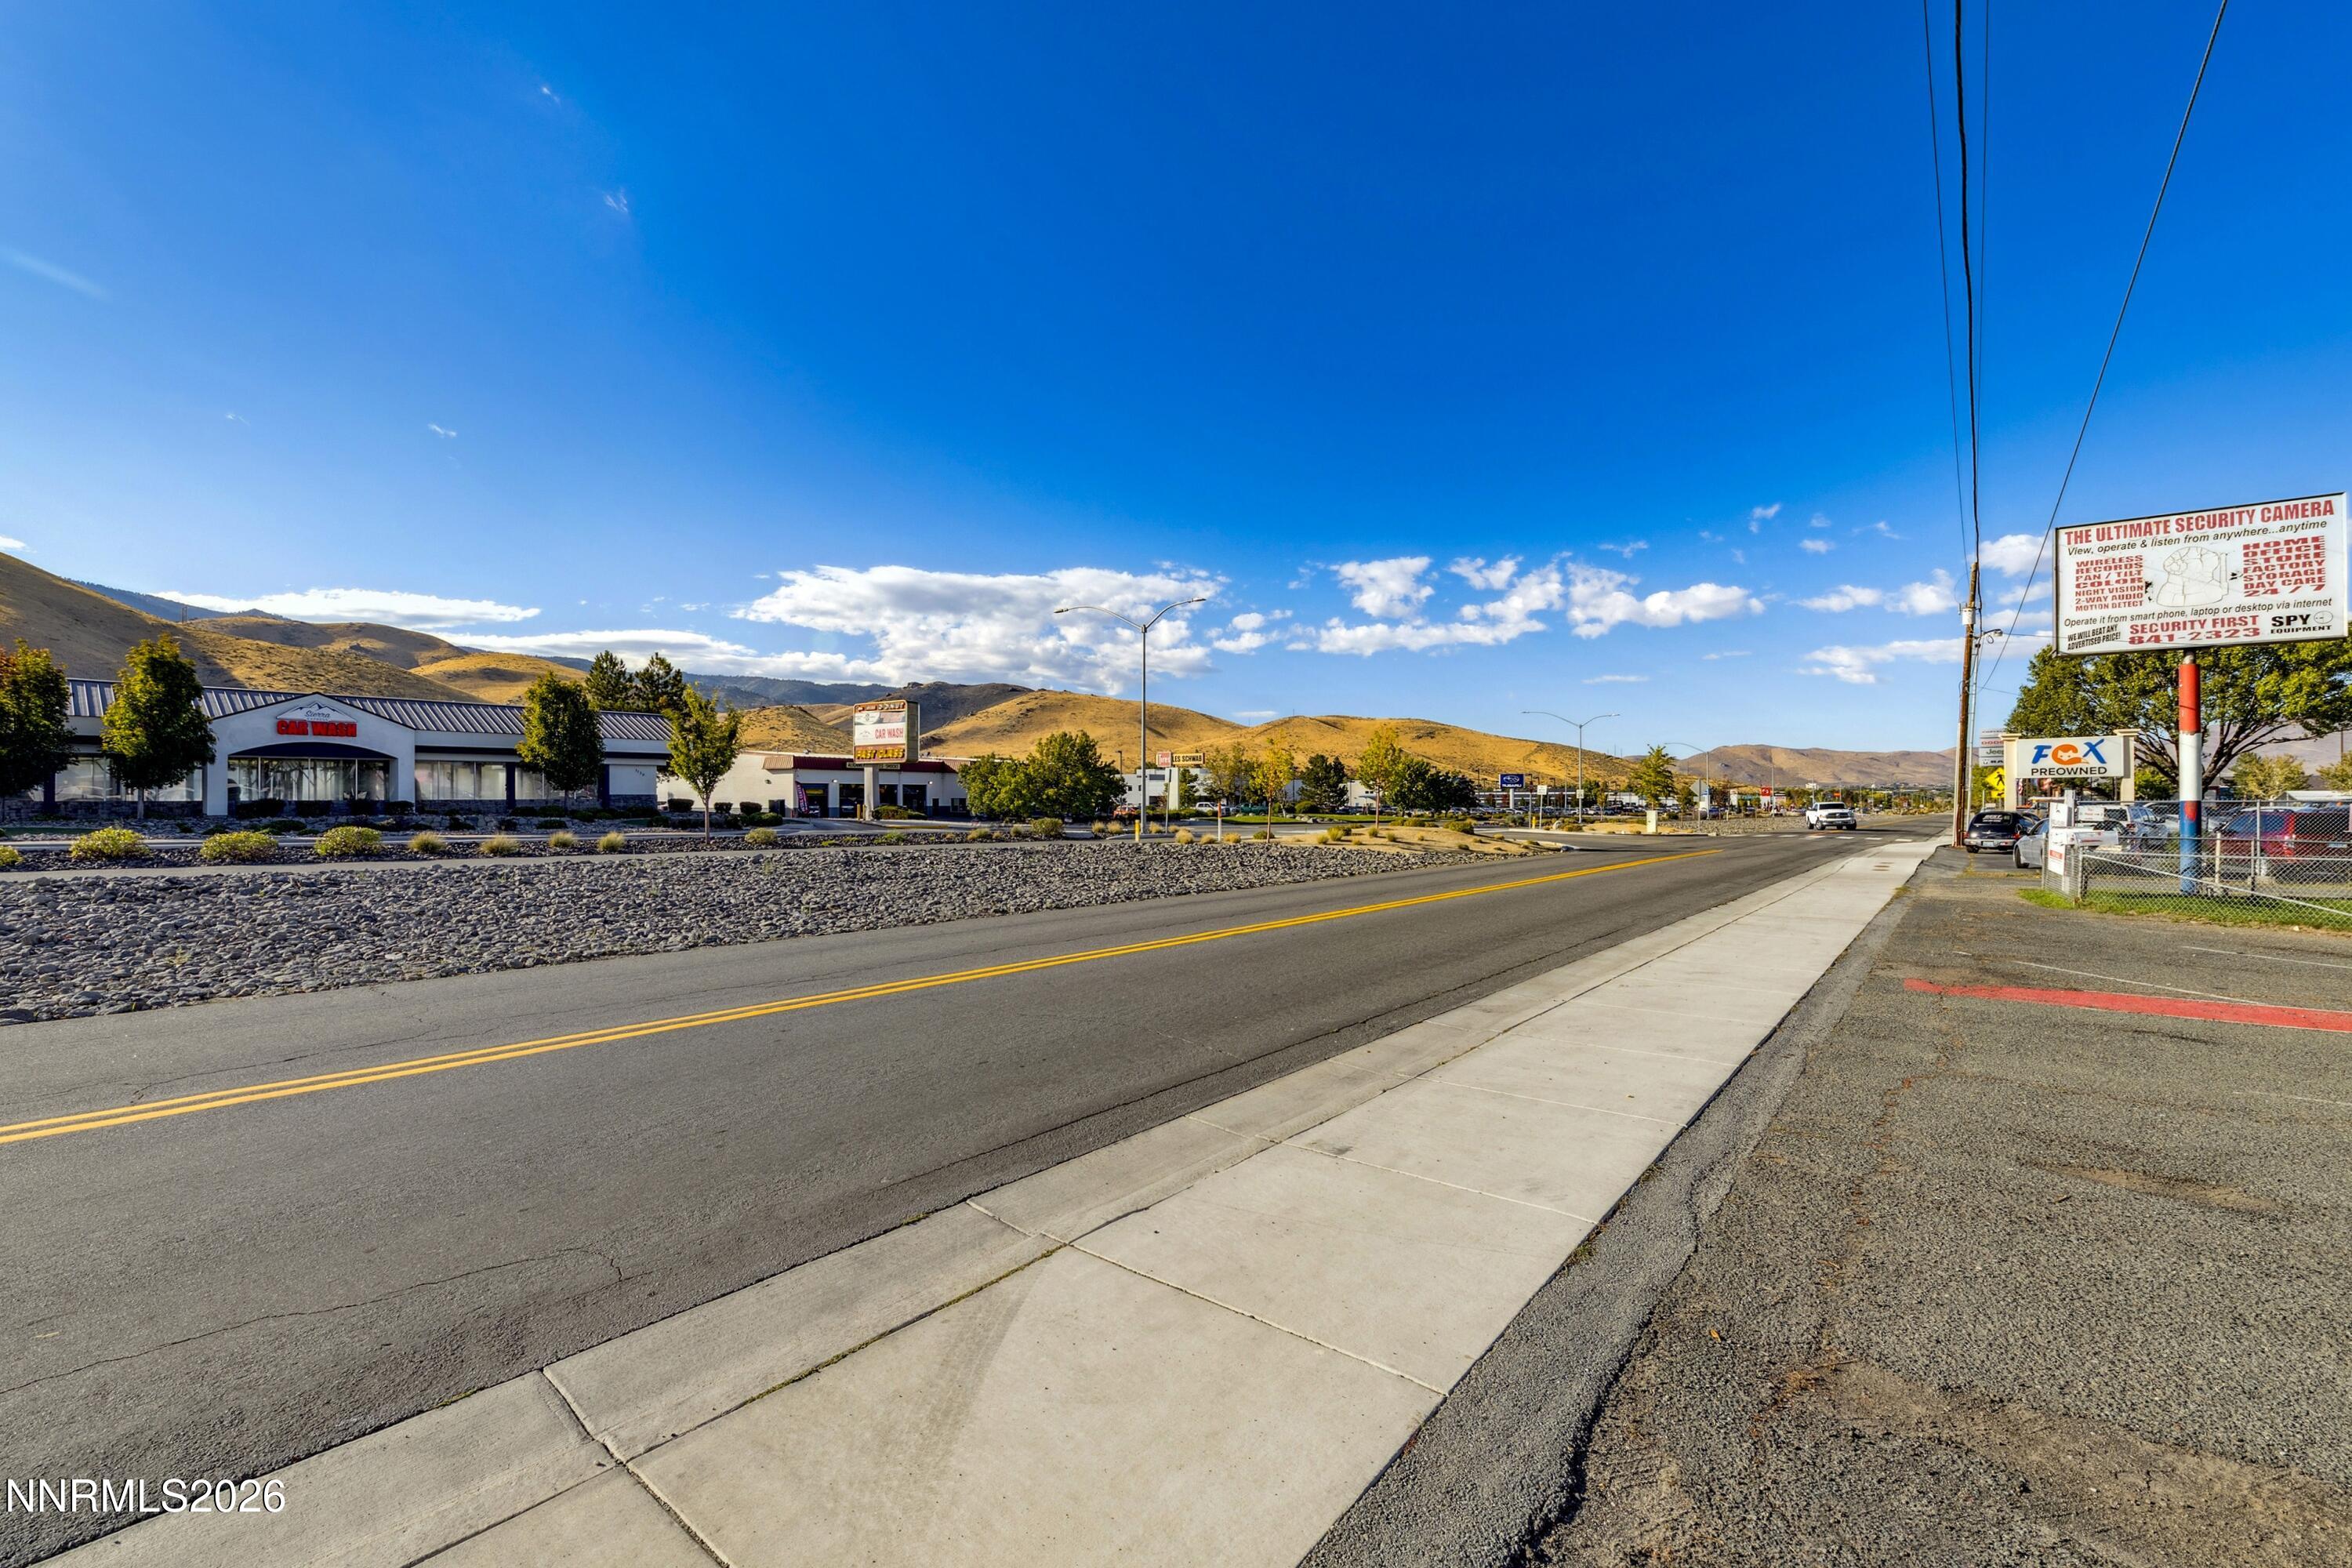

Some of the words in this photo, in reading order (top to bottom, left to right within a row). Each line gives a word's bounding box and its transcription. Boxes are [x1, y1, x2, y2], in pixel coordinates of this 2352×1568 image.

[2065, 529, 2092, 545] THE
[2096, 520, 2170, 542] ULTIMATE
[2176, 510, 2256, 532] SECURITY
[2261, 500, 2334, 522] CAMERA
[2067, 547, 2093, 556] View,
[2097, 542, 2136, 554] operate
[2151, 537, 2180, 546] listen
[2184, 533, 2209, 544] from
[2242, 535, 2325, 550] HOME
[2243, 543, 2325, 557] OFFICE
[2076, 555, 2143, 568] WIRELESS
[2244, 551, 2325, 565] STORE
[2076, 562, 2143, 574] RECORDS
[2117, 569, 2143, 578] TILT
[2243, 559, 2325, 574] FACTORY
[2244, 568, 2326, 582] STORAGE
[2075, 577, 2143, 589] COLOR
[2244, 581, 2275, 590] DAY
[2281, 575, 2326, 586] CARE
[2109, 586, 2143, 594] VISION
[2244, 588, 2280, 597] 24
[2075, 596, 2108, 604] 2-WAY
[2111, 593, 2143, 601] AUDIO
[2064, 618, 2097, 627] Operate
[2100, 615, 2105, 624] it
[2107, 614, 2127, 622] from
[2129, 612, 2154, 622] smart
[2158, 609, 2187, 621] phone,
[2190, 607, 2220, 618] laptop
[2234, 602, 2273, 613] desktop
[2293, 597, 2332, 608] internet
[2075, 602, 2109, 612] MOTION
[2111, 601, 2143, 609] DETECT
[2129, 619, 2207, 634] SECURITY
[2212, 615, 2259, 628] FIRST
[2271, 614, 2311, 627] SPY
[2067, 633, 2076, 642] WE
[2078, 630, 2090, 640] WILL
[2092, 627, 2106, 637] BEAT
[2107, 624, 2118, 634] ANY
[2128, 628, 2260, 645] 841-2323
[2270, 625, 2332, 634] EQUIPMENT
[2067, 635, 2100, 651] ADVERTISED
[2102, 632, 2121, 643] PRICE!
[277, 720, 308, 735] CAR
[311, 721, 357, 737] WASH
[875, 728, 886, 739] CAR
[887, 727, 904, 738] WASH
[2031, 767, 2107, 776] PREOWNED
